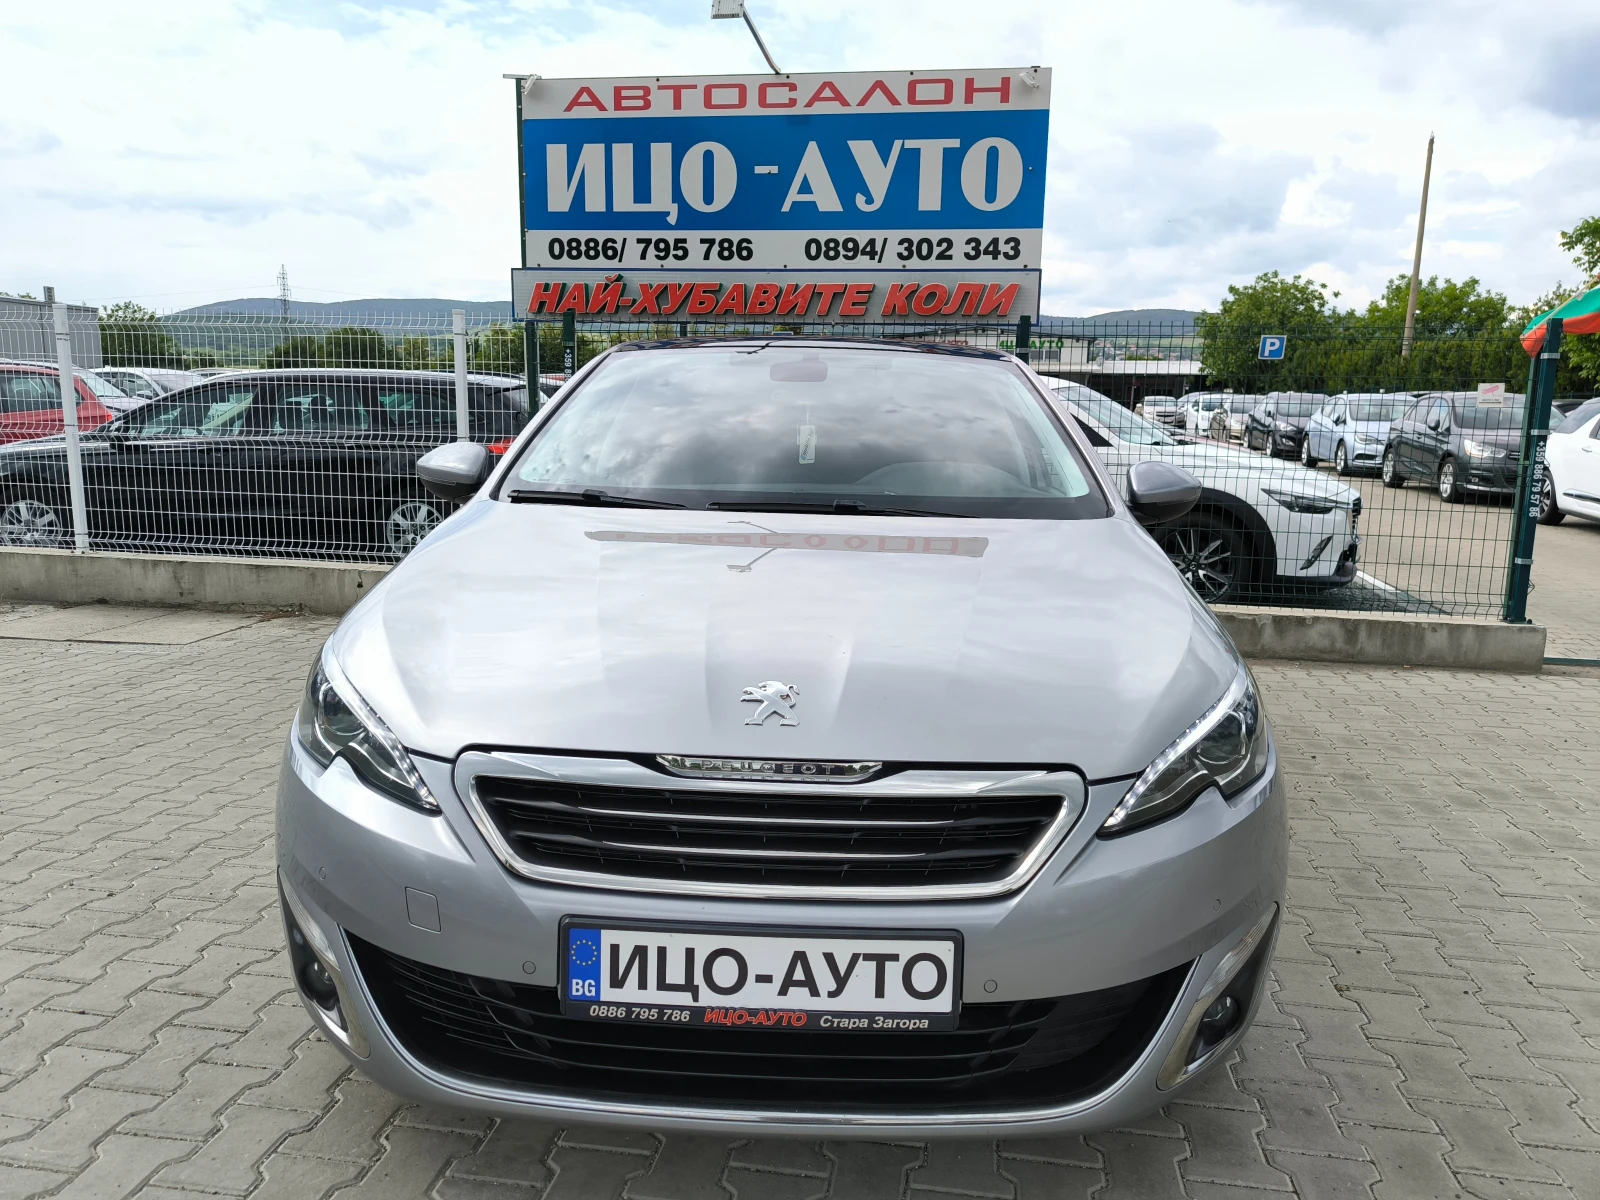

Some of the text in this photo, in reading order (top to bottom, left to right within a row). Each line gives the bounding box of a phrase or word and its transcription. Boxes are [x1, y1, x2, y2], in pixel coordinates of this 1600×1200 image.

[563, 76, 1011, 112] АВТОСАЛОН
[548, 237, 753, 263] 0886/ 795 786
[804, 237, 1021, 263] 0894/ 302 343
[527, 273, 1021, 316] НАЙ-ХУБАВИТЕ КОЛИ
[564, 348, 573, 368] +359
[1264, 338, 1280, 357] P
[1528, 440, 1546, 517] +359 886 79 57 86
[701, 759, 835, 775] PEUGEOT
[609, 943, 948, 1003] ИЦО-АУТО
[571, 978, 596, 997] BG
[589, 1005, 691, 1022] 0886 795 786
[703, 1008, 929, 1030] ИЦО-АУТО Стара Загора
